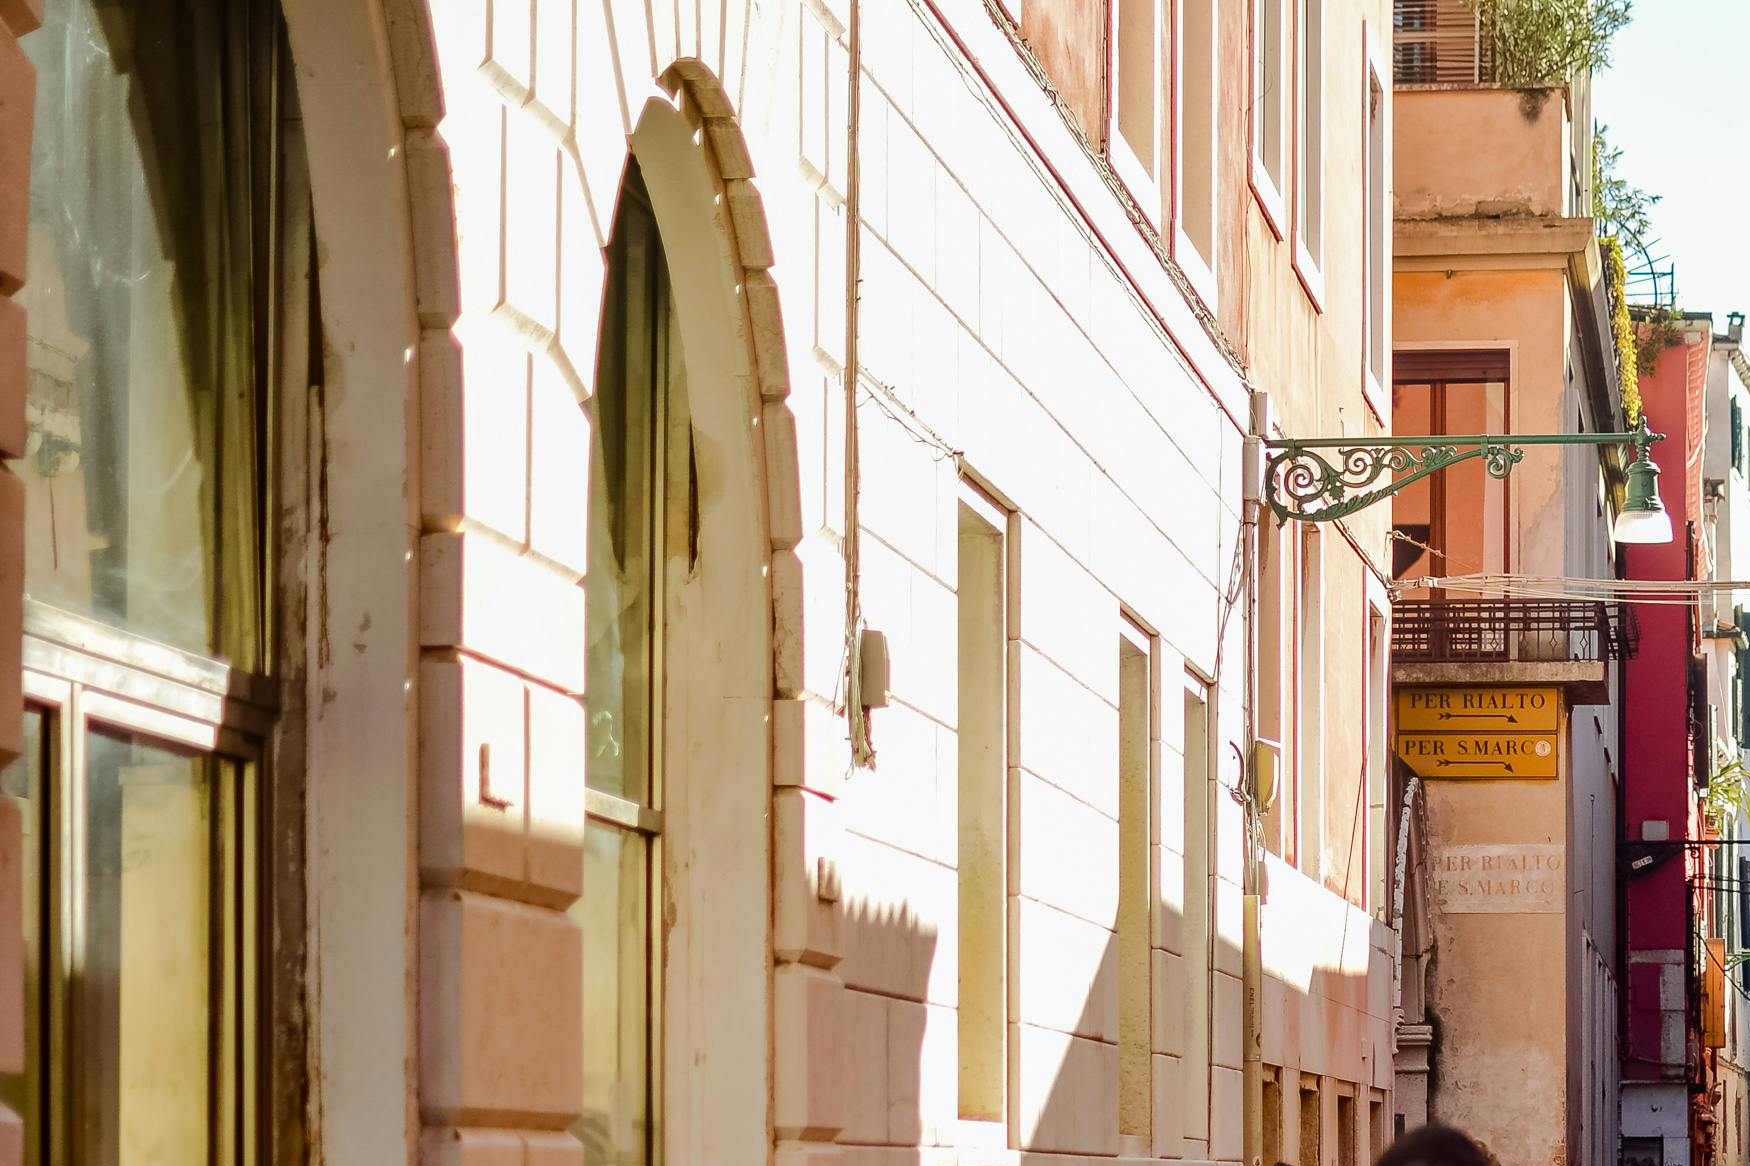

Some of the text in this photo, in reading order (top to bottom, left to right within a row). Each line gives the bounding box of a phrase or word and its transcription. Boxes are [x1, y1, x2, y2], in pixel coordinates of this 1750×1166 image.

[1411, 693, 1545, 710] PER RIALTO
[1404, 740, 1551, 756] PER S.MARC
[1431, 855, 1562, 871] PER RIALTO
